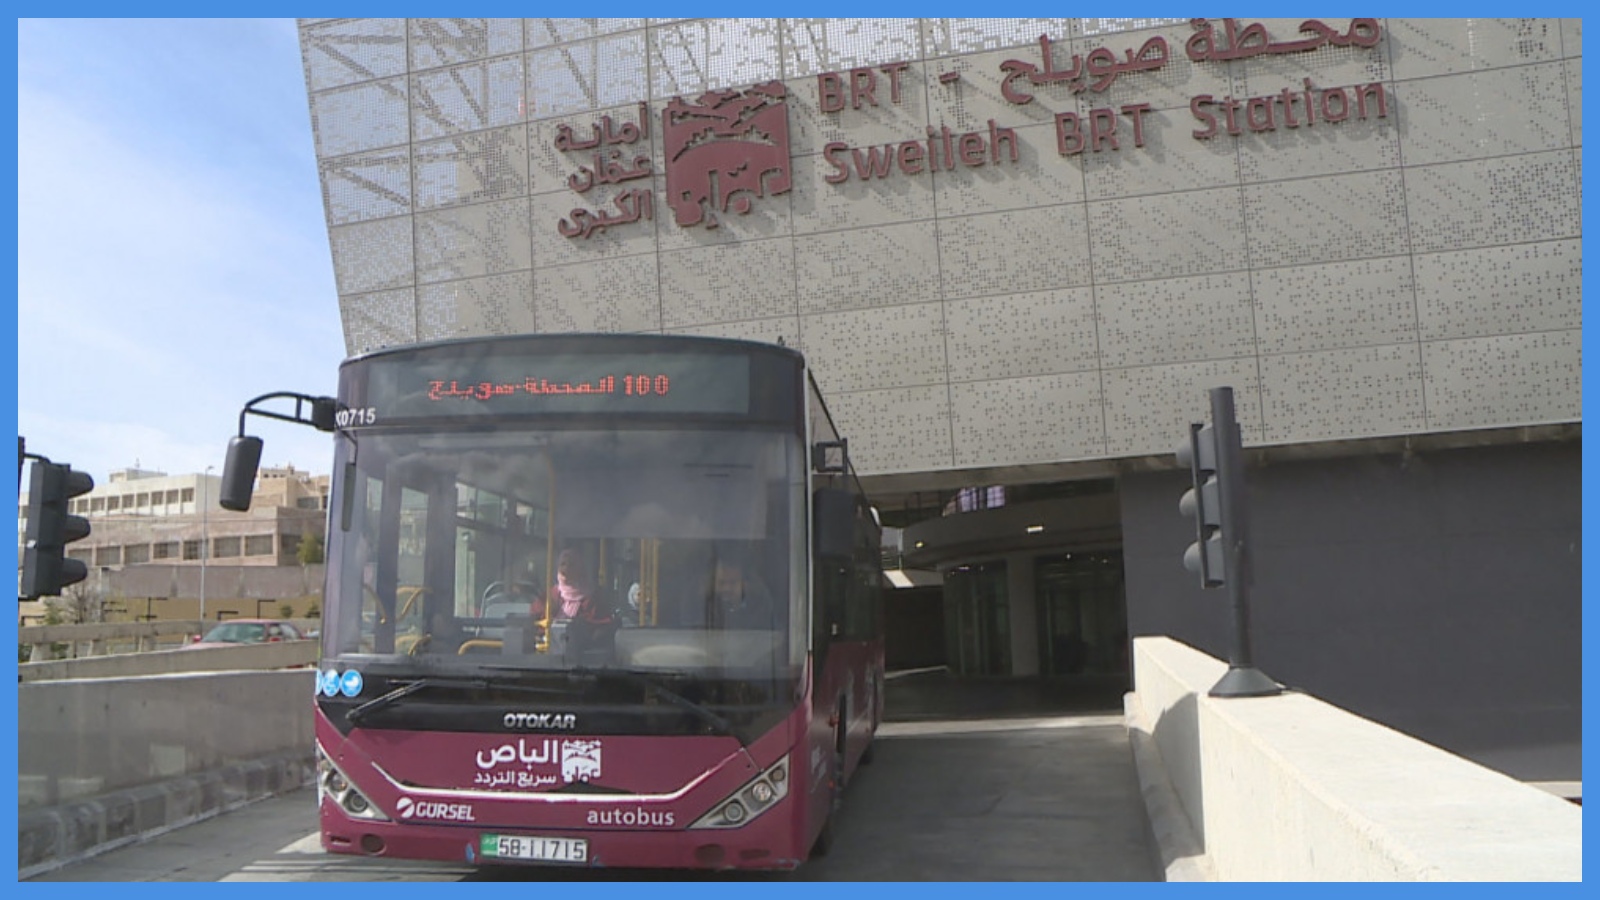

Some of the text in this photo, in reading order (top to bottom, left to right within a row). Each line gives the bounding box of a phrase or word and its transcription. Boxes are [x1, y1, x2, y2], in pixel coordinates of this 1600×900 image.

[1186, 18, 1380, 62] محطة
[818, 62, 907, 113] BRT
[1000, 34, 1169, 104] صويلح
[823, 77, 1389, 184] Sweileh BRT Station
[558, 189, 652, 239] الكبرى
[623, 374, 669, 396] 100
[503, 713, 577, 729] OTOKAR
[476, 739, 559, 770] الباص
[474, 770, 557, 787] سريع التردد
[587, 807, 675, 826] autobus
